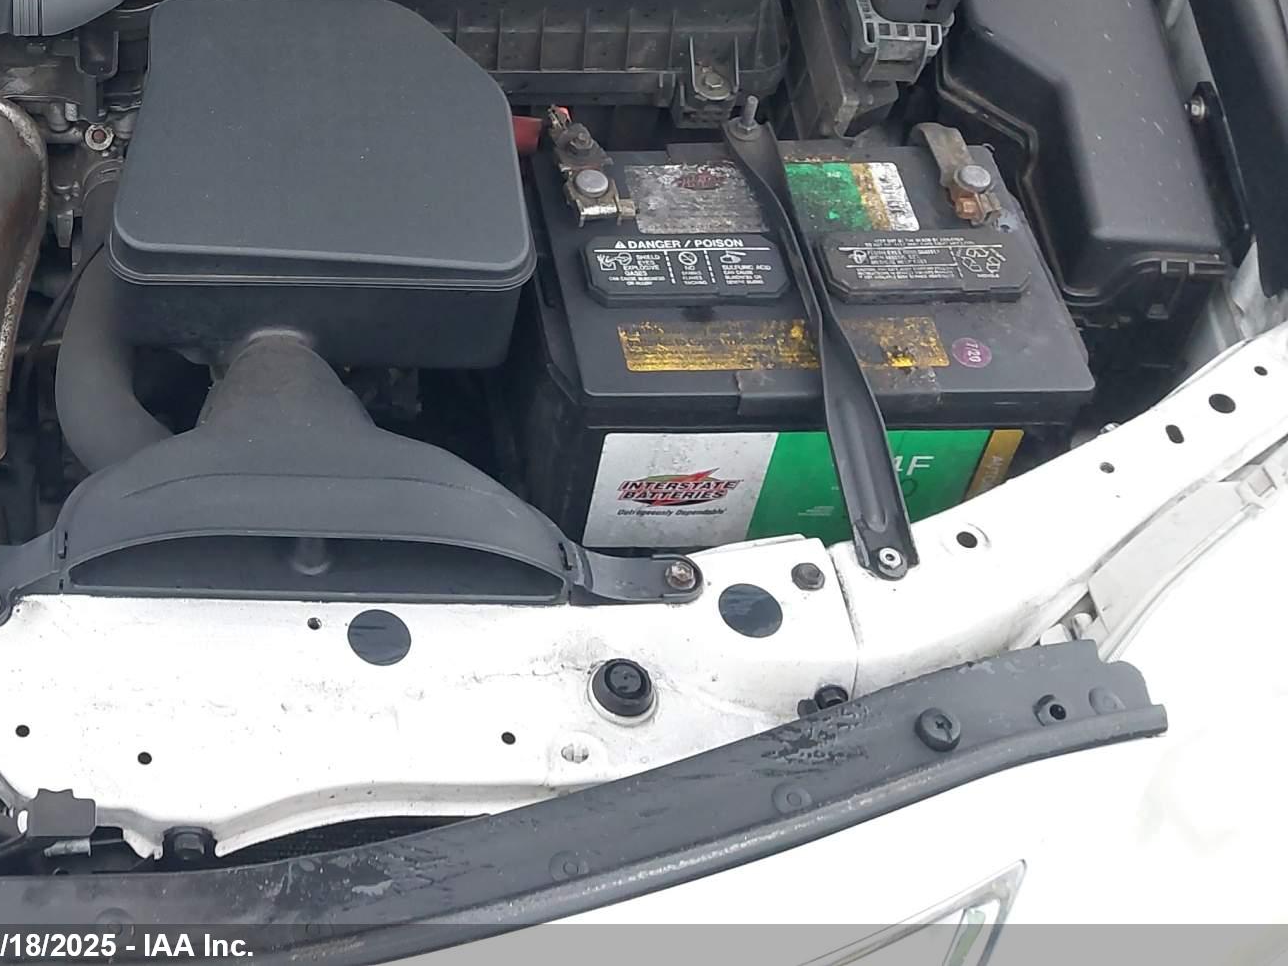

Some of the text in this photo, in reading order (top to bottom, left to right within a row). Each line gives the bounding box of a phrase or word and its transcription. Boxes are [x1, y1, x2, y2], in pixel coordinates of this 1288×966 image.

[627, 239, 681, 249] DANGER
[693, 238, 744, 248] POISON
[618, 480, 739, 491] INTERSTATE
[618, 490, 727, 501] BATTERIES
